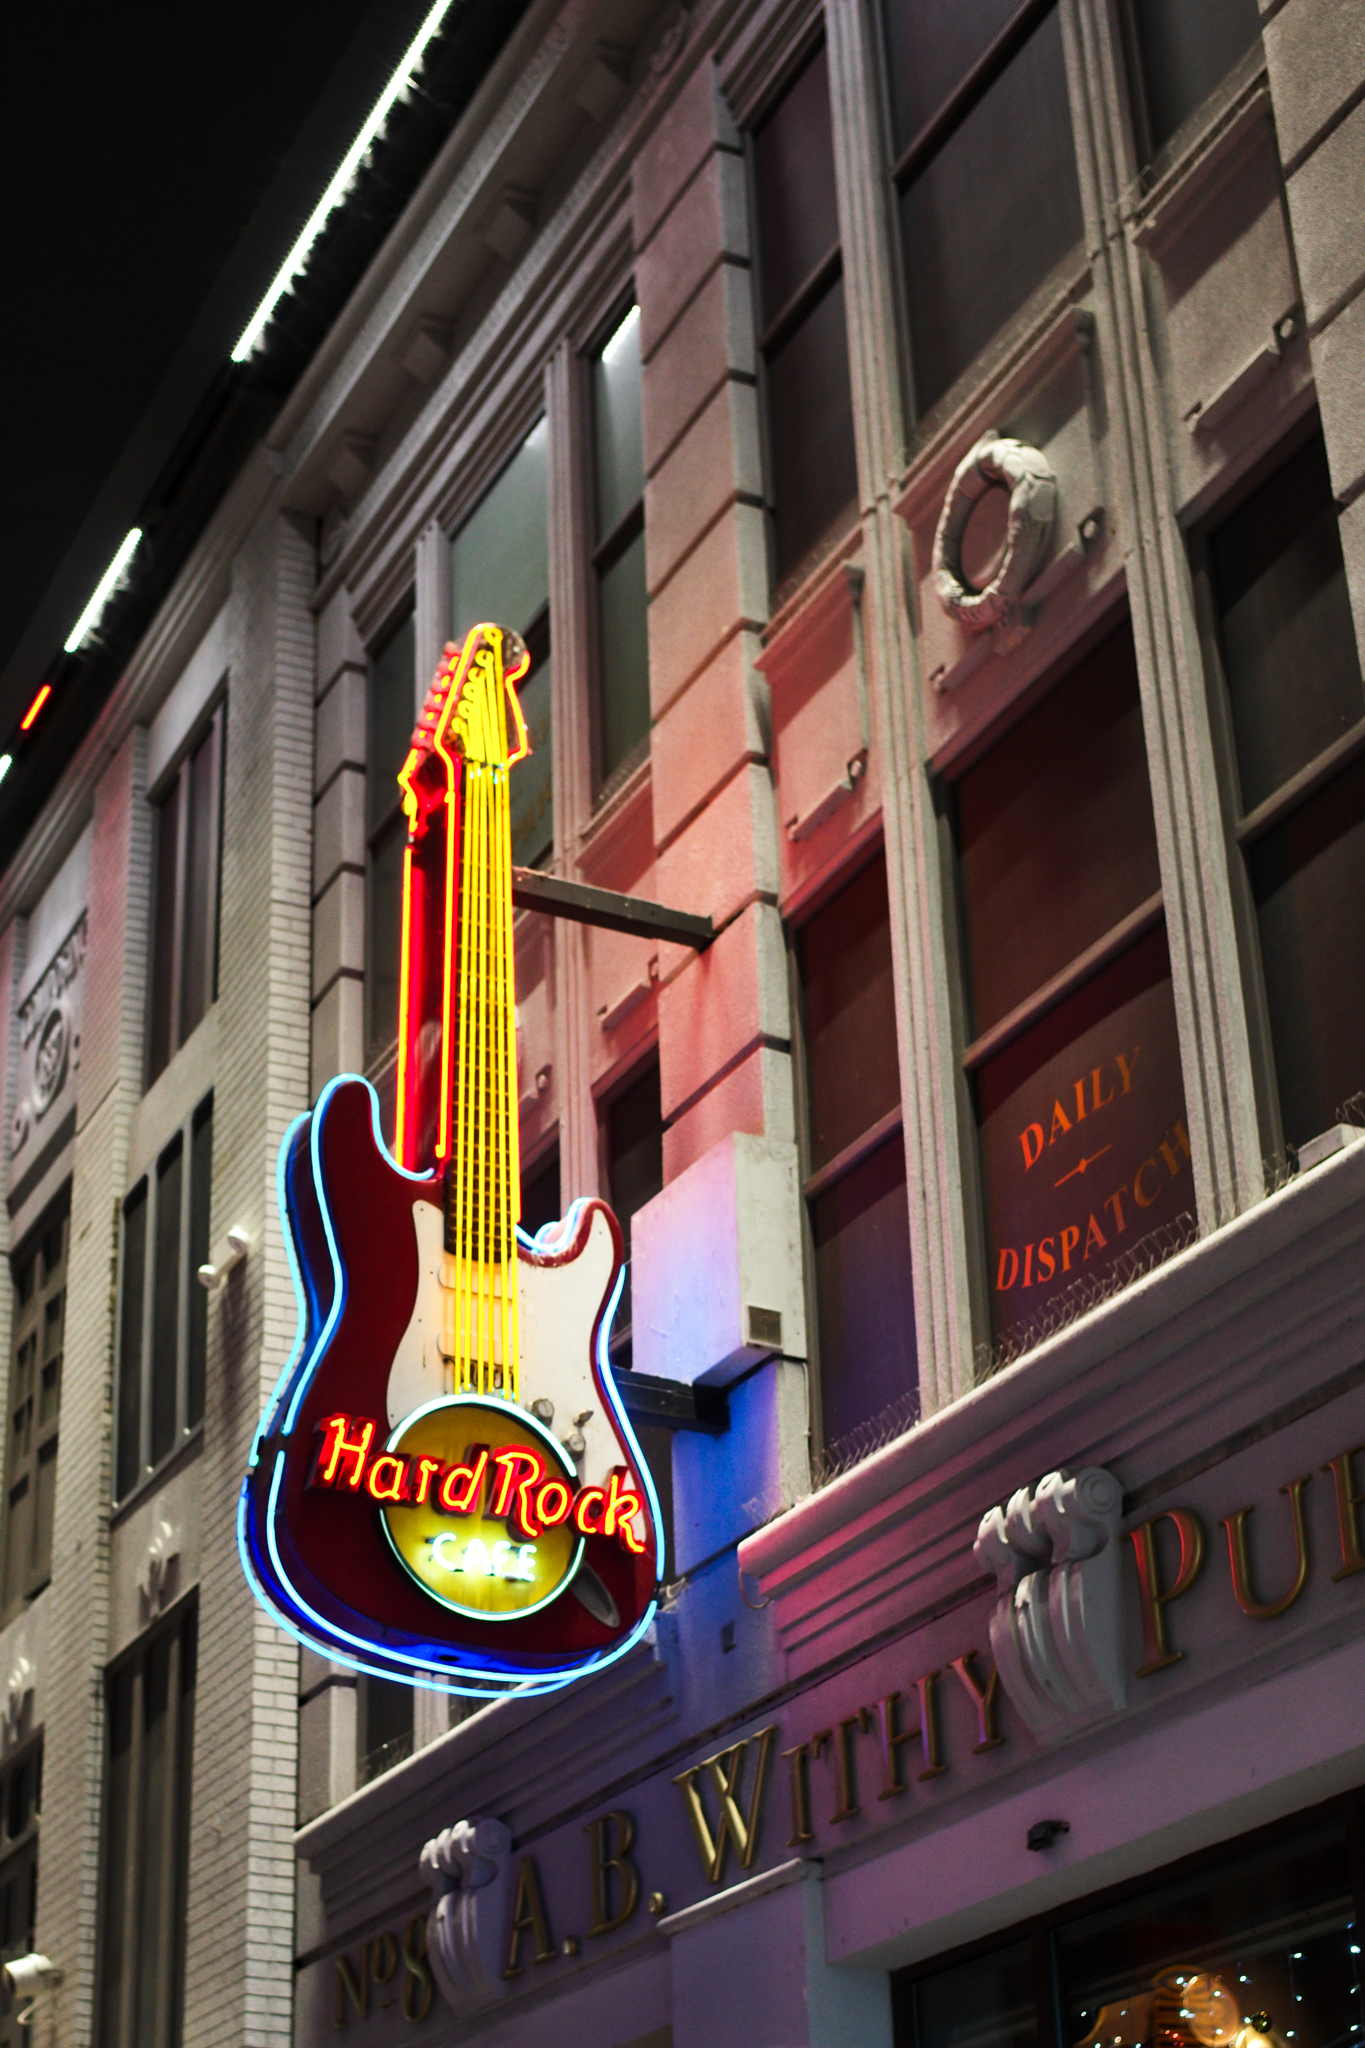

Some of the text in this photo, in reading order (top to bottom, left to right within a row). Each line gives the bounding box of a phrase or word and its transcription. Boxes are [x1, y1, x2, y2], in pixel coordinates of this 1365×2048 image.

[1017, 1046, 1141, 1172] DAILY
[313, 1413, 646, 1553] Hard Rock
[432, 1532, 537, 1582] CAFE
[670, 1650, 1004, 1883] WITHY
